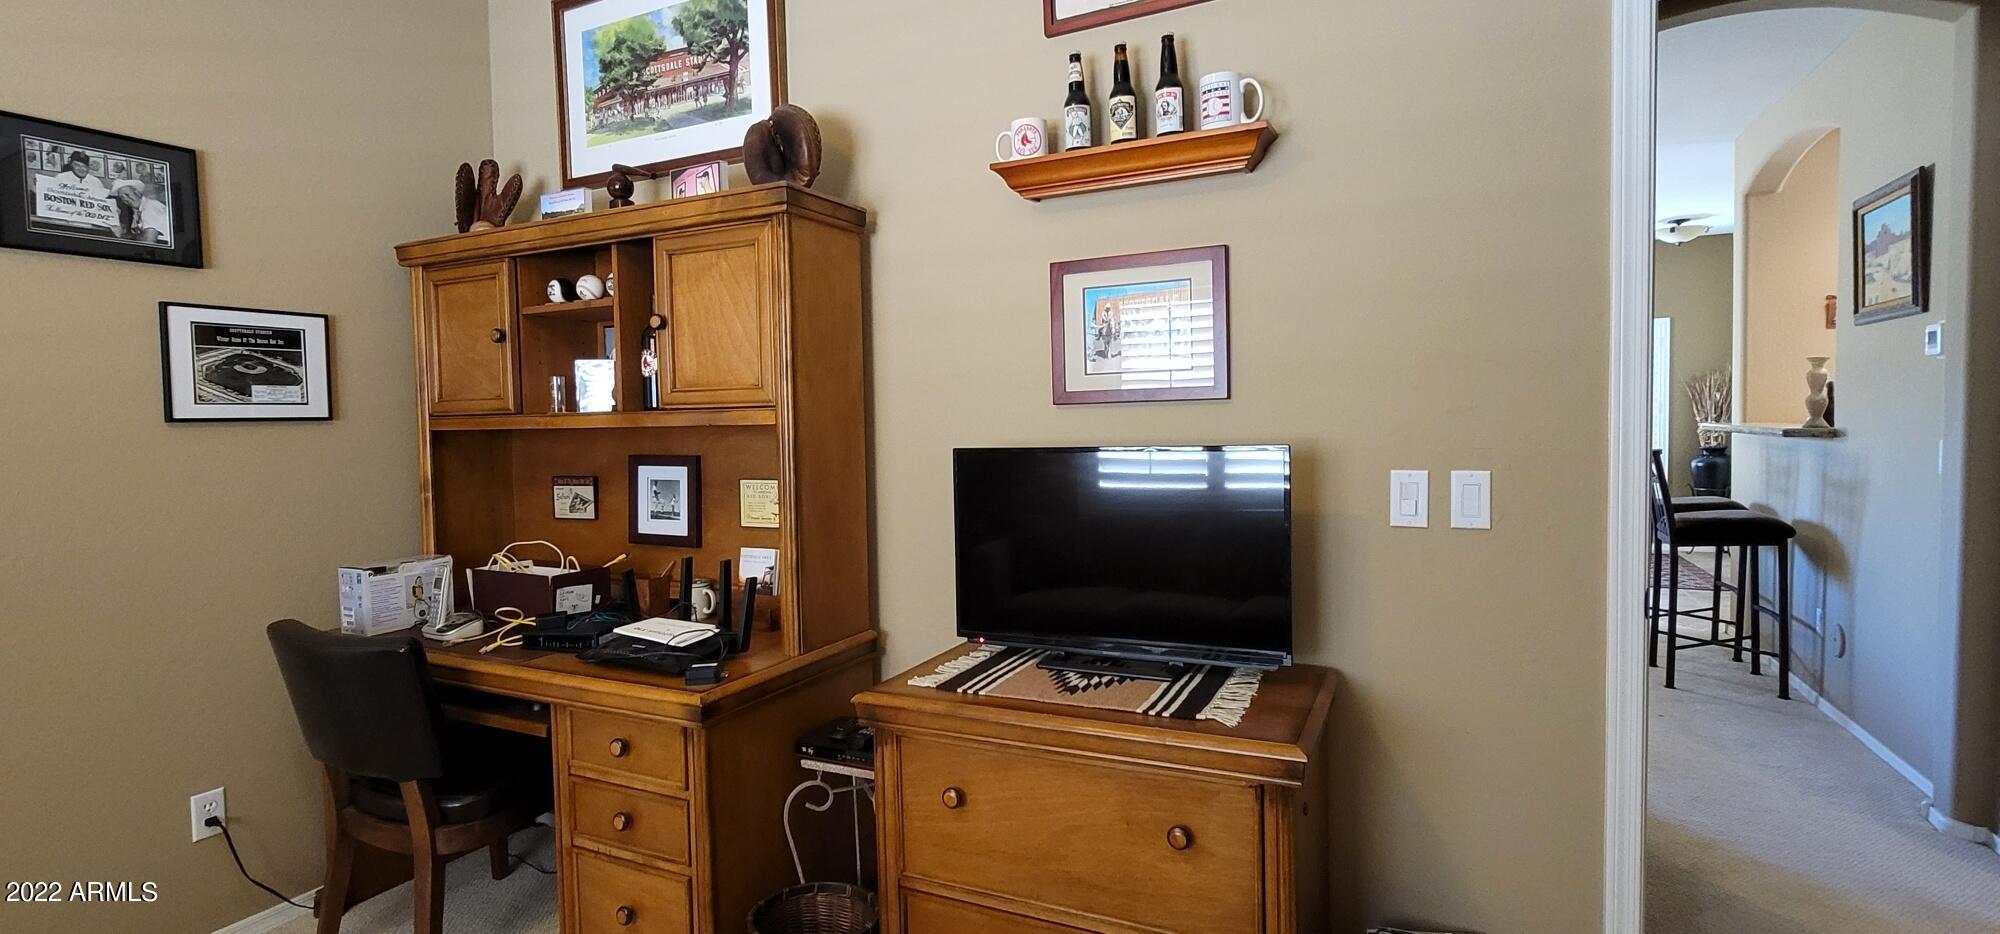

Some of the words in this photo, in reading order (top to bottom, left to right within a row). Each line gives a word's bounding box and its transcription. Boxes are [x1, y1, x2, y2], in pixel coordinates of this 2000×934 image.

[43, 192, 78, 206] BOSTON
[79, 199, 95, 209] RED
[97, 202, 113, 213] SOX
